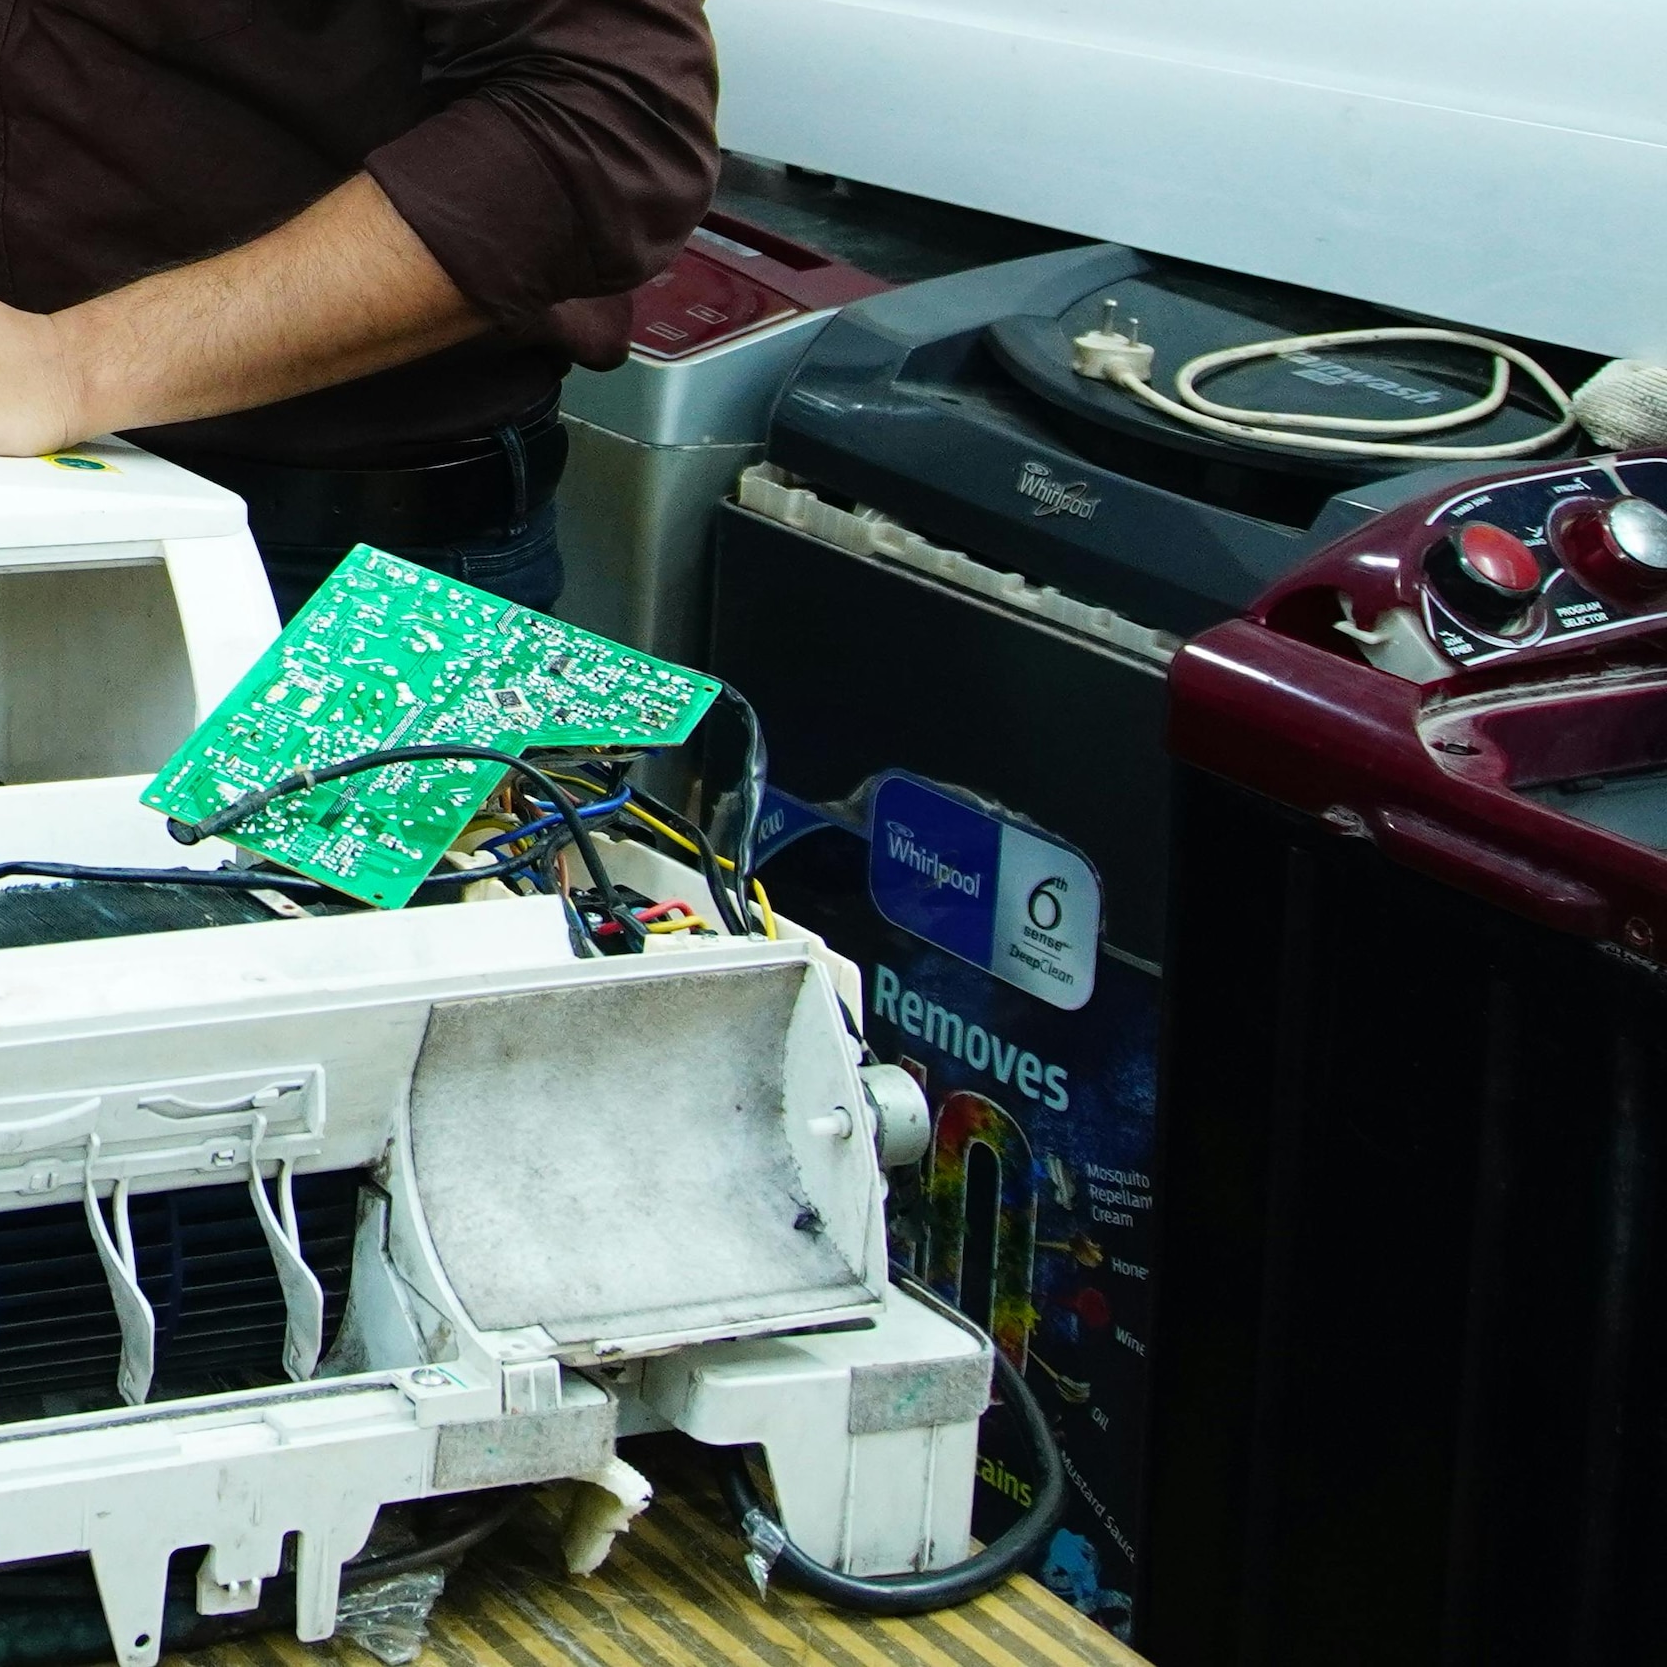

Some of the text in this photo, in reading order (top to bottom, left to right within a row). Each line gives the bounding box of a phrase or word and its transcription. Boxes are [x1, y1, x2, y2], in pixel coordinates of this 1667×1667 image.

[1020, 470, 1101, 520] Whirlpool
[1556, 601, 1603, 618] PROGRAM
[1562, 613, 1609, 628] SELECTOR
[1447, 643, 1475, 657] TIMER
[886, 831, 981, 899] Whirlpool
[1009, 943, 1074, 985] DeepClean
[874, 963, 1069, 1112] Removes
[1086, 1162, 1150, 1188] Mosquito
[1092, 1204, 1134, 1227] Cream
[1092, 1405, 1109, 1432] Oil
